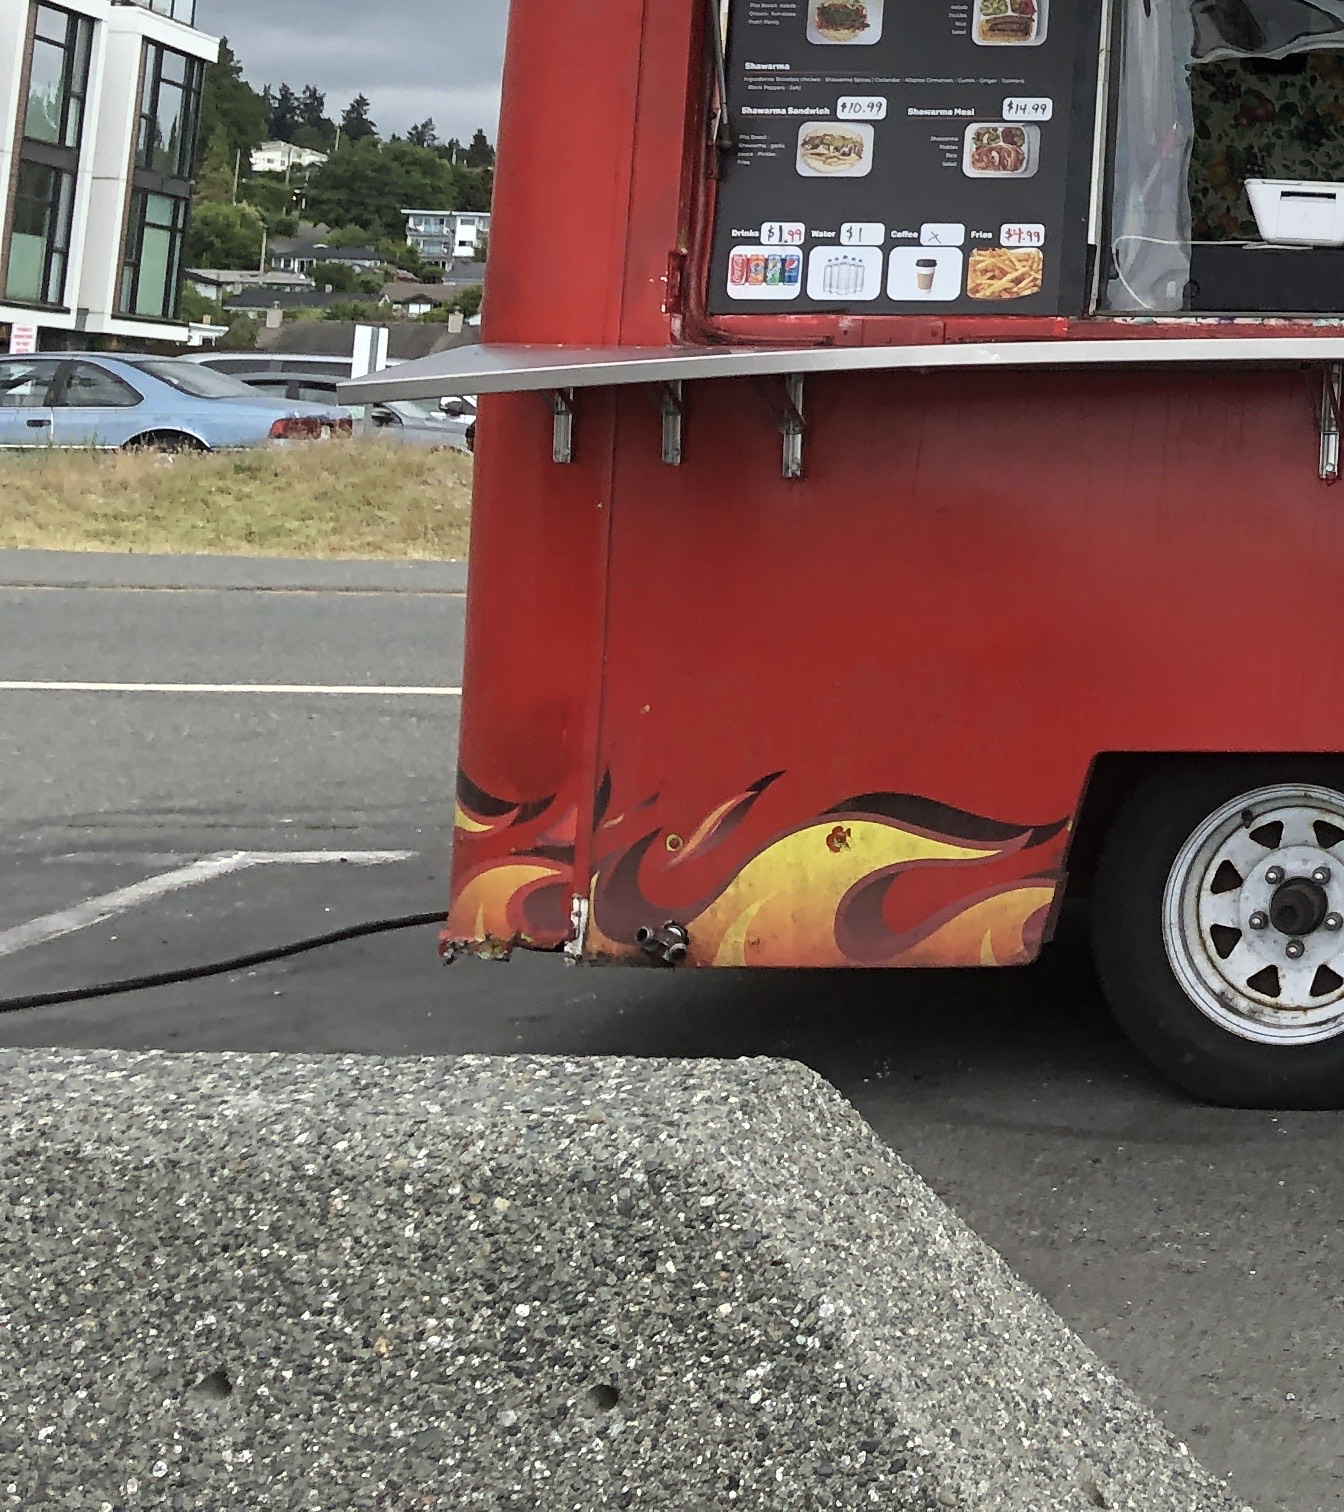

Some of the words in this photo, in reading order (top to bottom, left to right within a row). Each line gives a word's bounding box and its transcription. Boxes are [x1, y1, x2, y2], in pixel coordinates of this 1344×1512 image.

[744, 61, 791, 70] Shawarma
[741, 106, 787, 115] Shawarma
[787, 106, 831, 115] Sandwich
[840, 100, 883, 115] $10.99
[907, 107, 953, 116] Shawarma
[1006, 99, 1048, 116] $14.99
[731, 228, 760, 237] Drinks
[767, 224, 802, 243] $1.99
[811, 229, 837, 238] Water
[890, 229, 919, 239] Coffee
[970, 230, 993, 239] Fries
[1004, 227, 1041, 244] $4.99
